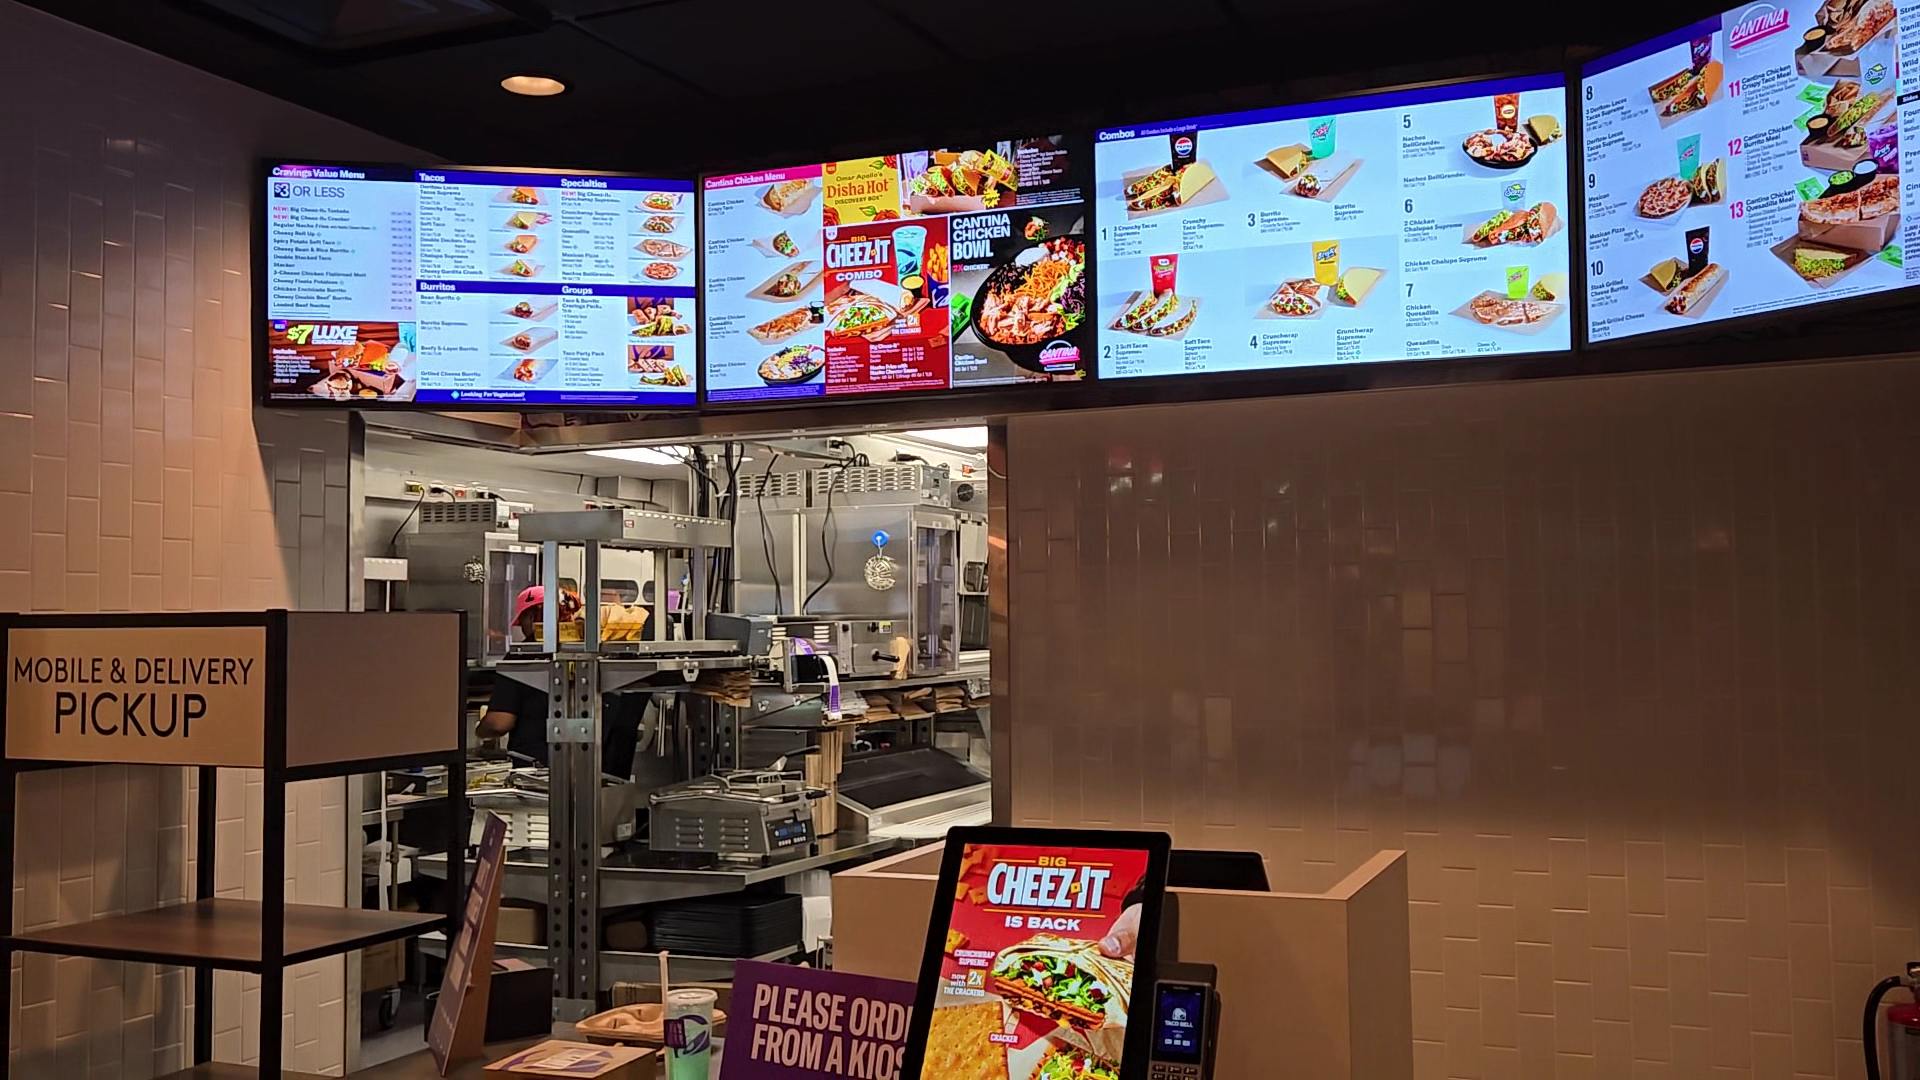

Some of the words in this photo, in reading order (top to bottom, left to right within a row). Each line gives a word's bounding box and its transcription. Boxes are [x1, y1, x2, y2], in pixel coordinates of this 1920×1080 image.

[1730, 9, 1786, 41] CANTINA
[1902, 58, 1918, 68] Wild
[1742, 73, 1765, 83] Cantina
[1766, 65, 1791, 76] Chicken
[1742, 81, 1760, 90] Crispy
[1777, 70, 1791, 79] Meal
[1729, 80, 1740, 97] 11
[1903, 77, 1917, 86] Mtn
[1586, 86, 1592, 100] 8
[1602, 105, 1624, 116] Supreme
[1403, 115, 1411, 128] 5
[1099, 130, 1135, 140] Combos
[1744, 132, 1767, 141] Cantina
[1768, 124, 1792, 135] Chicken
[1403, 140, 1440, 148] BellGrande
[1602, 137, 1625, 147] Supreme
[1728, 138, 1742, 156] 12
[1744, 139, 1764, 148] Burrito
[1766, 134, 1780, 142] Meal
[272, 167, 312, 178] Cravings
[312, 169, 338, 179] Value
[340, 170, 365, 179] Menu
[419, 173, 445, 182] Tacos
[856, 172, 883, 180] Apollo's
[561, 179, 607, 188] Specialties
[706, 179, 733, 188] Cantina
[735, 176, 763, 184] Chicken
[1589, 174, 1595, 188] 9
[293, 186, 310, 196] OR
[315, 186, 345, 198] LESS
[826, 181, 864, 198] Disha
[867, 179, 888, 192] Hot
[835, 197, 866, 205] DISCOVERY
[1746, 196, 1769, 205] Cantina
[1770, 190, 1795, 199] Chicken
[1746, 200, 1777, 212] Quesadilla
[1779, 195, 1794, 204] Meal
[1405, 199, 1413, 213] 6
[1730, 202, 1743, 219] 13
[953, 214, 1010, 230] CANTINA
[1248, 213, 1255, 226] 3
[953, 226, 1010, 241] CHICKEN
[1102, 228, 1106, 240] 1
[1590, 230, 1611, 240] Mexican
[826, 240, 890, 268] CHEEZ-IT
[952, 240, 994, 260] BOWL
[952, 264, 963, 272] 2X
[1591, 260, 1603, 276] 10
[836, 270, 882, 282] COMBO
[421, 282, 455, 291] Burritos
[562, 286, 593, 295] Groups
[1406, 283, 1414, 297] 7
[1591, 283, 1605, 291] Steak
[1606, 279, 1623, 287] Grilled
[1592, 319, 1606, 327] Steak
[1607, 316, 1624, 325] Grilled
[1625, 313, 1644, 321] Cheese
[287, 325, 314, 344] $7
[313, 326, 358, 339] LUXE
[1592, 326, 1610, 334] Burrito
[1250, 335, 1258, 349] 4
[1039, 346, 1080, 359] CANTINA
[1104, 345, 1111, 358] 2
[13, 657, 102, 684] MOBILE
[111, 658, 126, 684] &
[135, 657, 254, 685] DELIVERY
[55, 692, 207, 737] PICKUP
[1038, 856, 1067, 867] BIG
[987, 863, 1110, 910] CHEEZ-IT
[1005, 915, 1023, 928] IS
[1027, 917, 1081, 932] BACK
[954, 949, 995, 958] CRUNCHWRAP
[959, 958, 986, 966] SUPREME
[968, 971, 982, 985] 2x
[752, 983, 846, 1032] PLEASE
[990, 1034, 1018, 1043] CRACKER
[751, 1023, 824, 1071] FROM
[825, 1036, 842, 1075] A
